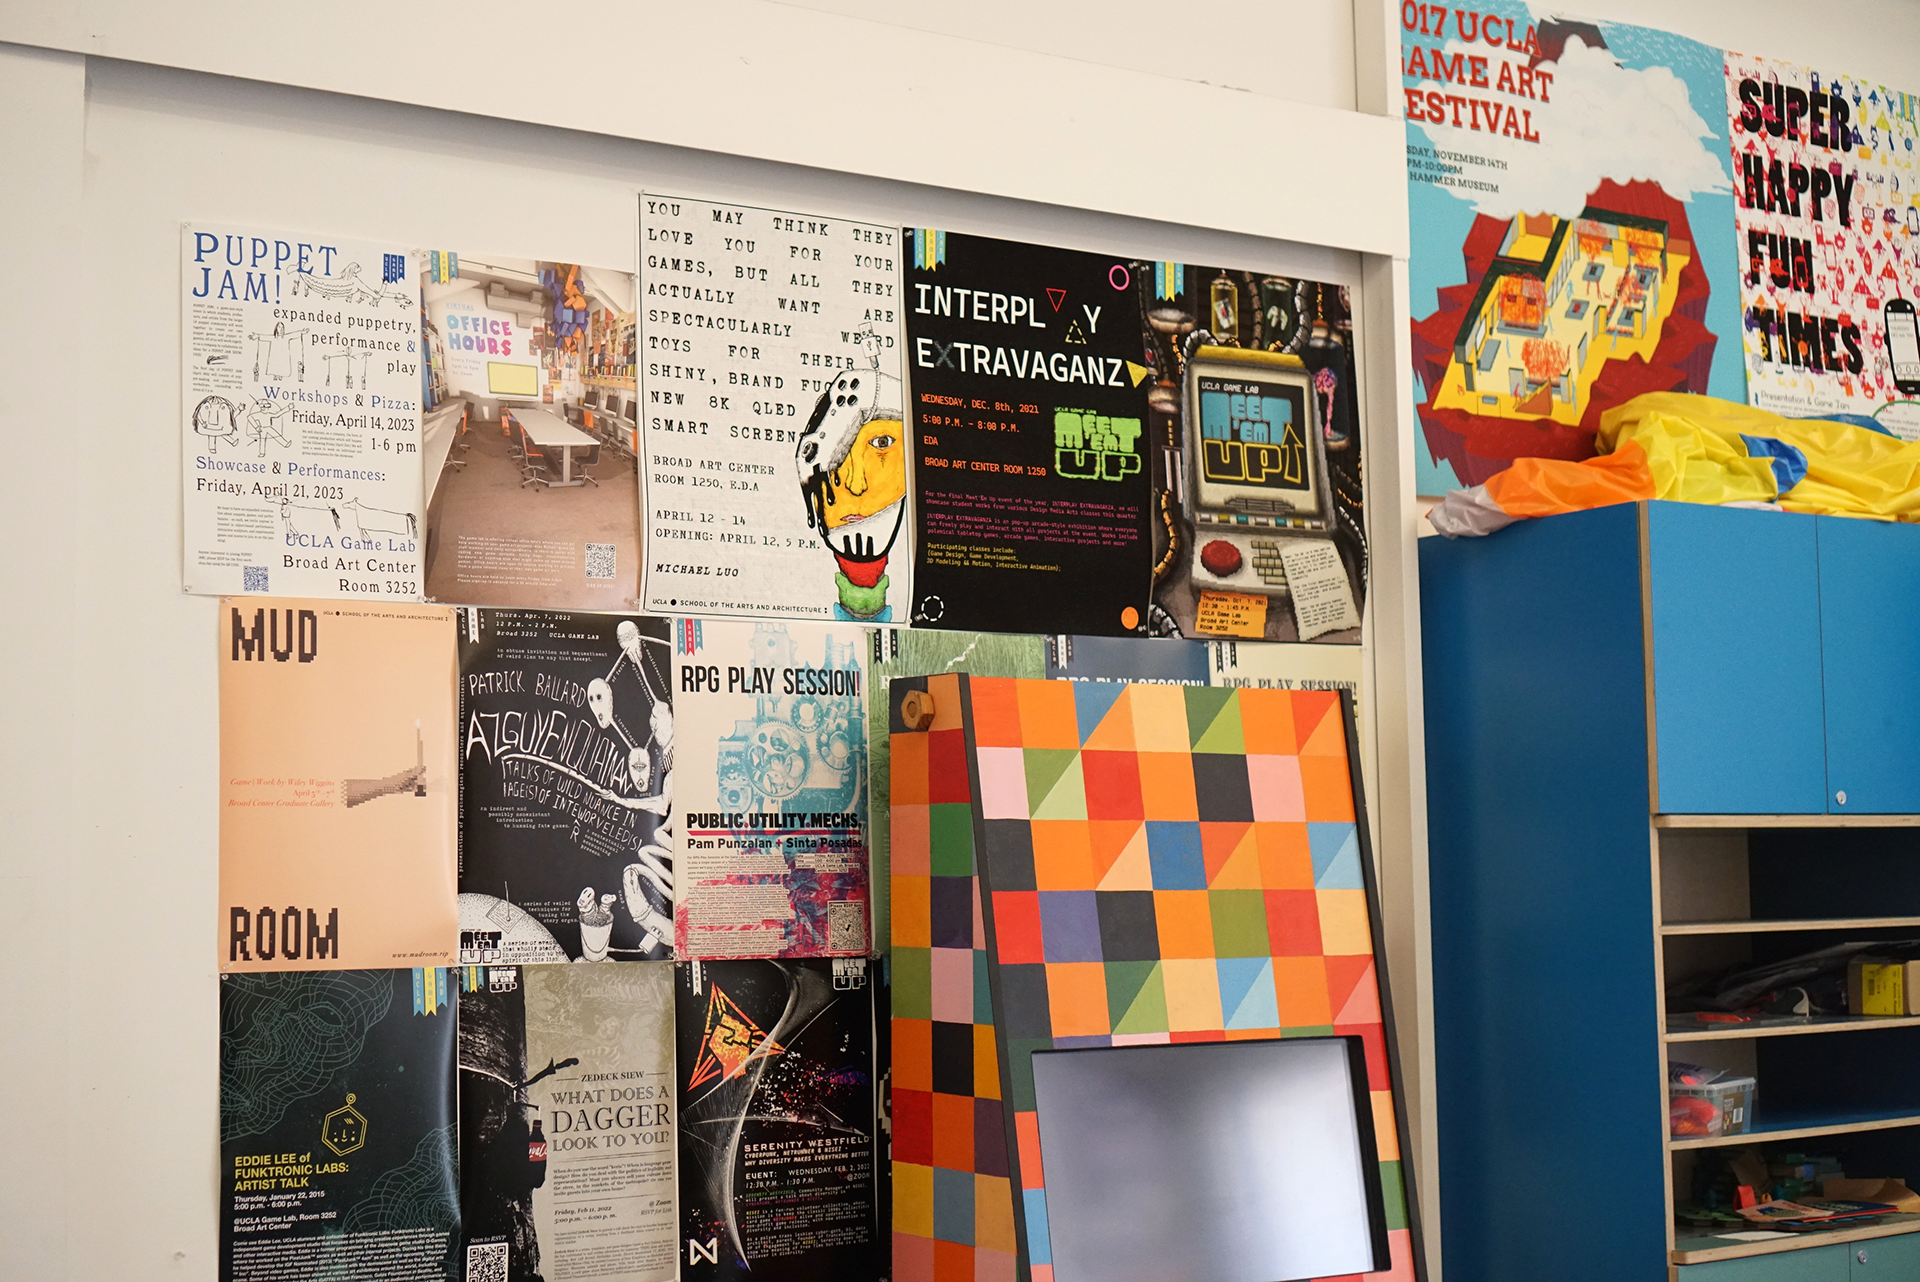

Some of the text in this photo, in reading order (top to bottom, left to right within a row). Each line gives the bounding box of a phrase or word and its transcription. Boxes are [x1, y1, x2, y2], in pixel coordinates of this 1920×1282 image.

[1456, 10, 1542, 57] UCLA
[1401, 45, 1553, 102] AME ART
[1404, 88, 1540, 143] ESTIVAL
[1739, 78, 1852, 152] SUPER
[1433, 149, 1486, 166] NOVEMBER
[1488, 160, 1508, 170] 14TH
[1410, 172, 1499, 193] HAMMER MUSEUM
[1742, 152, 1854, 228] HAPPY
[648, 202, 892, 246] YOU MAY THINK THEY
[194, 232, 338, 276] PUPPET
[648, 228, 892, 271] LOVE YOU FOR YOUR
[1748, 230, 1814, 294] FUN
[192, 268, 280, 304] JAM!
[648, 256, 892, 296] GAMES, BUT ALL THEY
[648, 283, 894, 322] ACTUALLY WANT ARE
[274, 307, 416, 334] expanded puppetry,
[446, 314, 512, 336] OFFICE
[650, 310, 894, 348] SPECTACULARLY WERD
[311, 332, 416, 353] performance &
[448, 332, 512, 356] HOURS
[1753, 306, 1864, 374] TIMES
[650, 336, 854, 370] TOYS FOR THEIR
[387, 361, 416, 376] play
[650, 364, 784, 390] SHINY, BRAND
[264, 386, 416, 411] Workshops & Pizza:
[1202, 382, 1259, 394] UCLA GAME LAB
[650, 391, 796, 416] NEW 8K QLED
[921, 393, 1040, 414] WEDNESDAY, DEC. 8th, 2021
[292, 409, 414, 432] Friday, April 14, 2023
[652, 418, 708, 434] SMART
[1202, 392, 1292, 444] MEET
[924, 436, 938, 446] EDA
[196, 455, 386, 482] Showcase & Performances:
[653, 455, 775, 475] BROAD ART CENTER
[924, 457, 1046, 476] BROAD ART CENTER ROOM 1250
[654, 474, 760, 492] ROOM 1250, E.D.A
[285, 533, 416, 552] UCLA Game Lab
[283, 554, 416, 574] Broad Art Center
[656, 563, 739, 577] MICHAEL LUO
[339, 579, 416, 594] Room 3252
[232, 607, 318, 663] MUD
[468, 670, 586, 708] PATRICK BALLARD
[682, 666, 860, 697] RPG PLAY SESSION!
[688, 838, 862, 849] Pam Punzalan Sinta Posadas
[230, 906, 338, 962] ROOM
[392, 951, 449, 960] www.mudroom.rip
[581, 1071, 645, 1083] ZEDECK SIEW
[551, 1086, 670, 1106] WHAT DOES A
[551, 1103, 671, 1134] DAGGER
[552, 1136, 598, 1152] LOOK
[602, 1134, 626, 1148] TO
[630, 1130, 670, 1146] YOU?
[744, 1136, 870, 1152] SERENITY WESTFIELD
[234, 1152, 311, 1168] EDDIE LEE of
[234, 1162, 349, 1180] FUNKTRONIC LABS:
[788, 1167, 833, 1176] WEDNESDAY,
[234, 1176, 310, 1192] ARTIST TALK
[234, 1196, 268, 1204] Thursday,
[269, 1193, 297, 1202] January
[554, 1208, 576, 1216] Friday,
